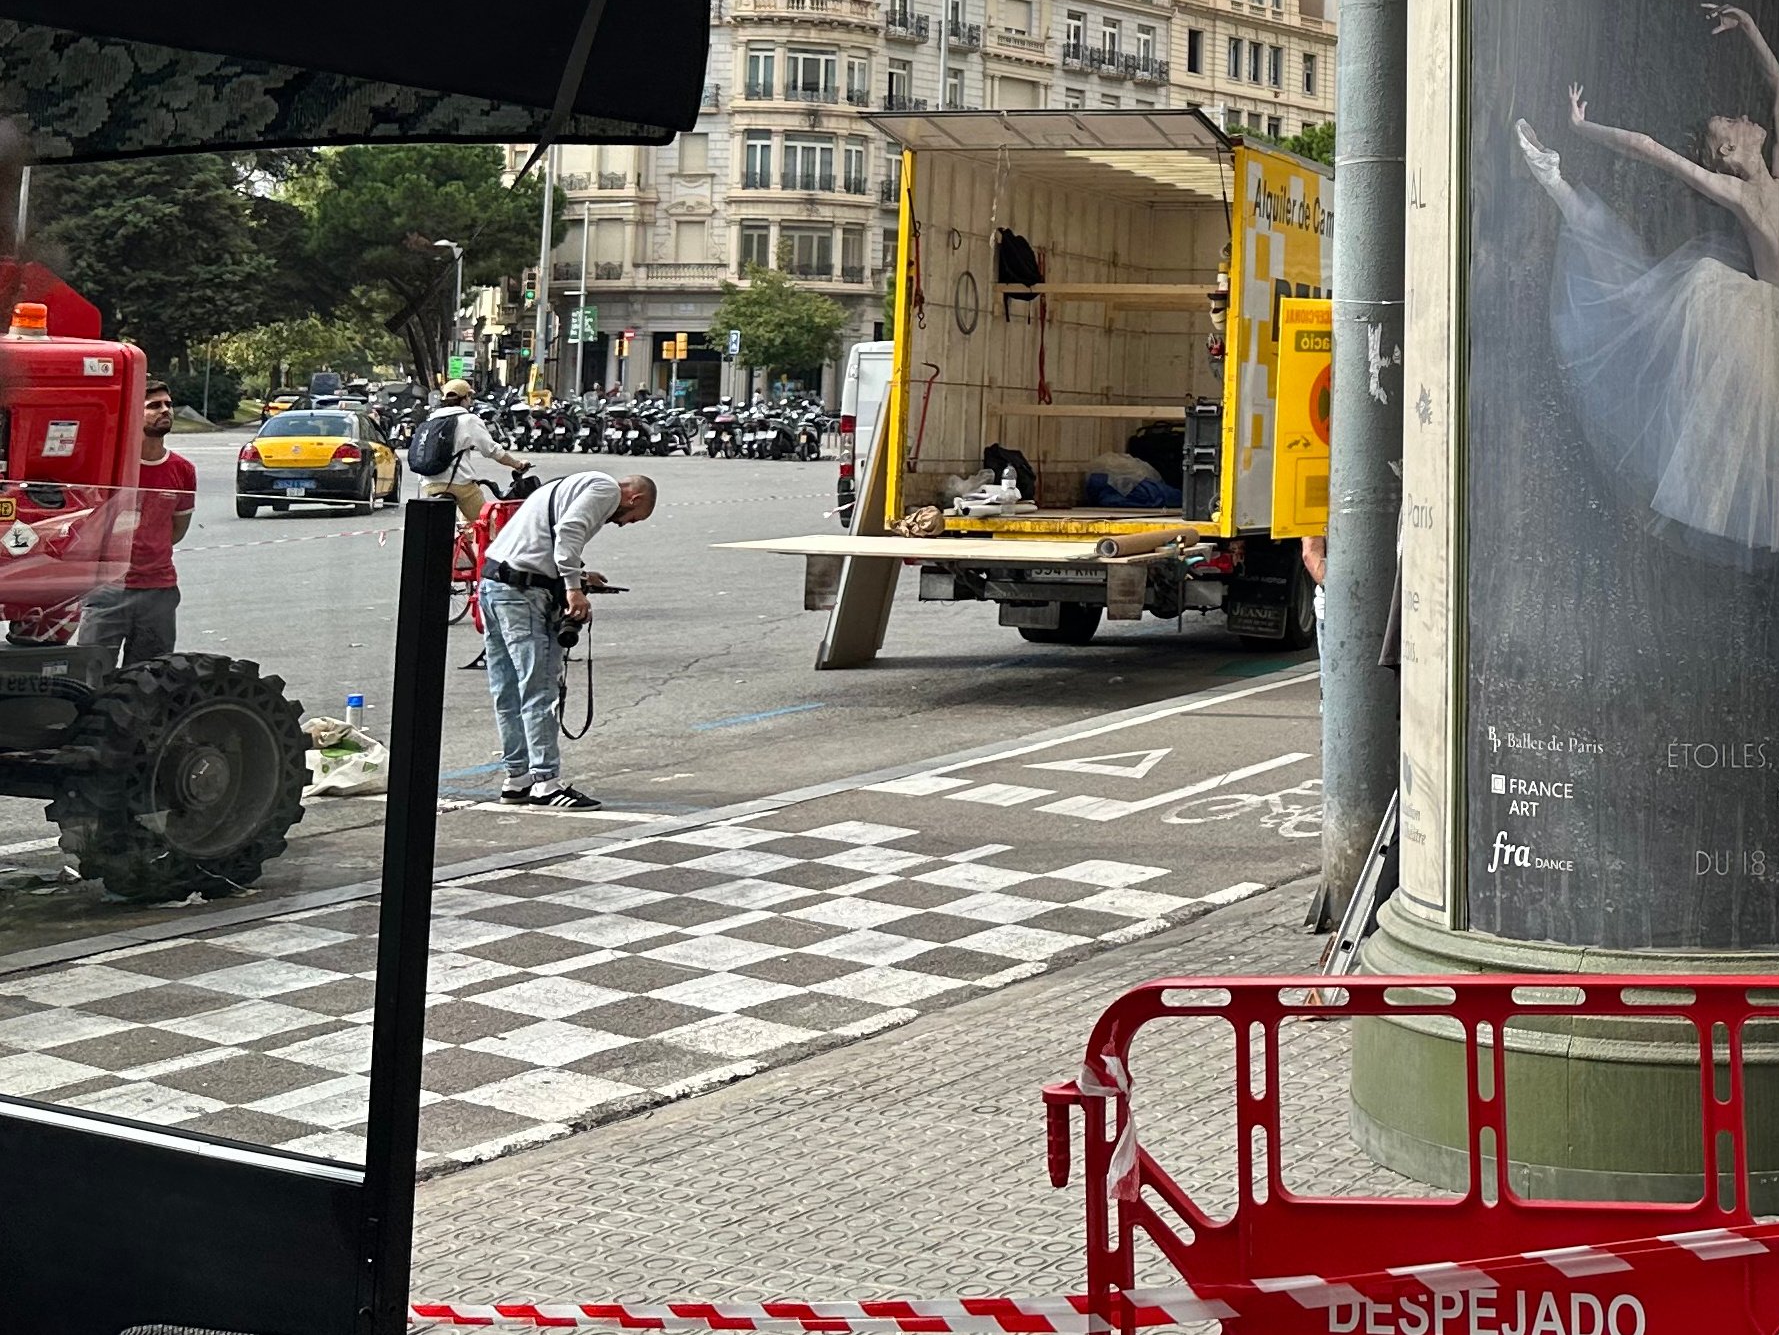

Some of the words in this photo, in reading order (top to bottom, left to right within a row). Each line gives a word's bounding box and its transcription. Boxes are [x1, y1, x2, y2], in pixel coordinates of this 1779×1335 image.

[1254, 177, 1297, 231] Alquiler
[1299, 192, 1311, 232] de
[1548, 735, 1564, 752] de
[1569, 737, 1604, 754] Paris
[1667, 738, 1773, 770] ÉTOILES,
[1510, 778, 1574, 799] FRANCE
[1509, 800, 1540, 817] ART
[1488, 830, 1531, 873] fra
[1535, 857, 1574, 872] DANCE
[1696, 849, 1730, 875] DU
[1744, 849, 1766, 876] 18
[1328, 1288, 1646, 1335] DESPEJADO
